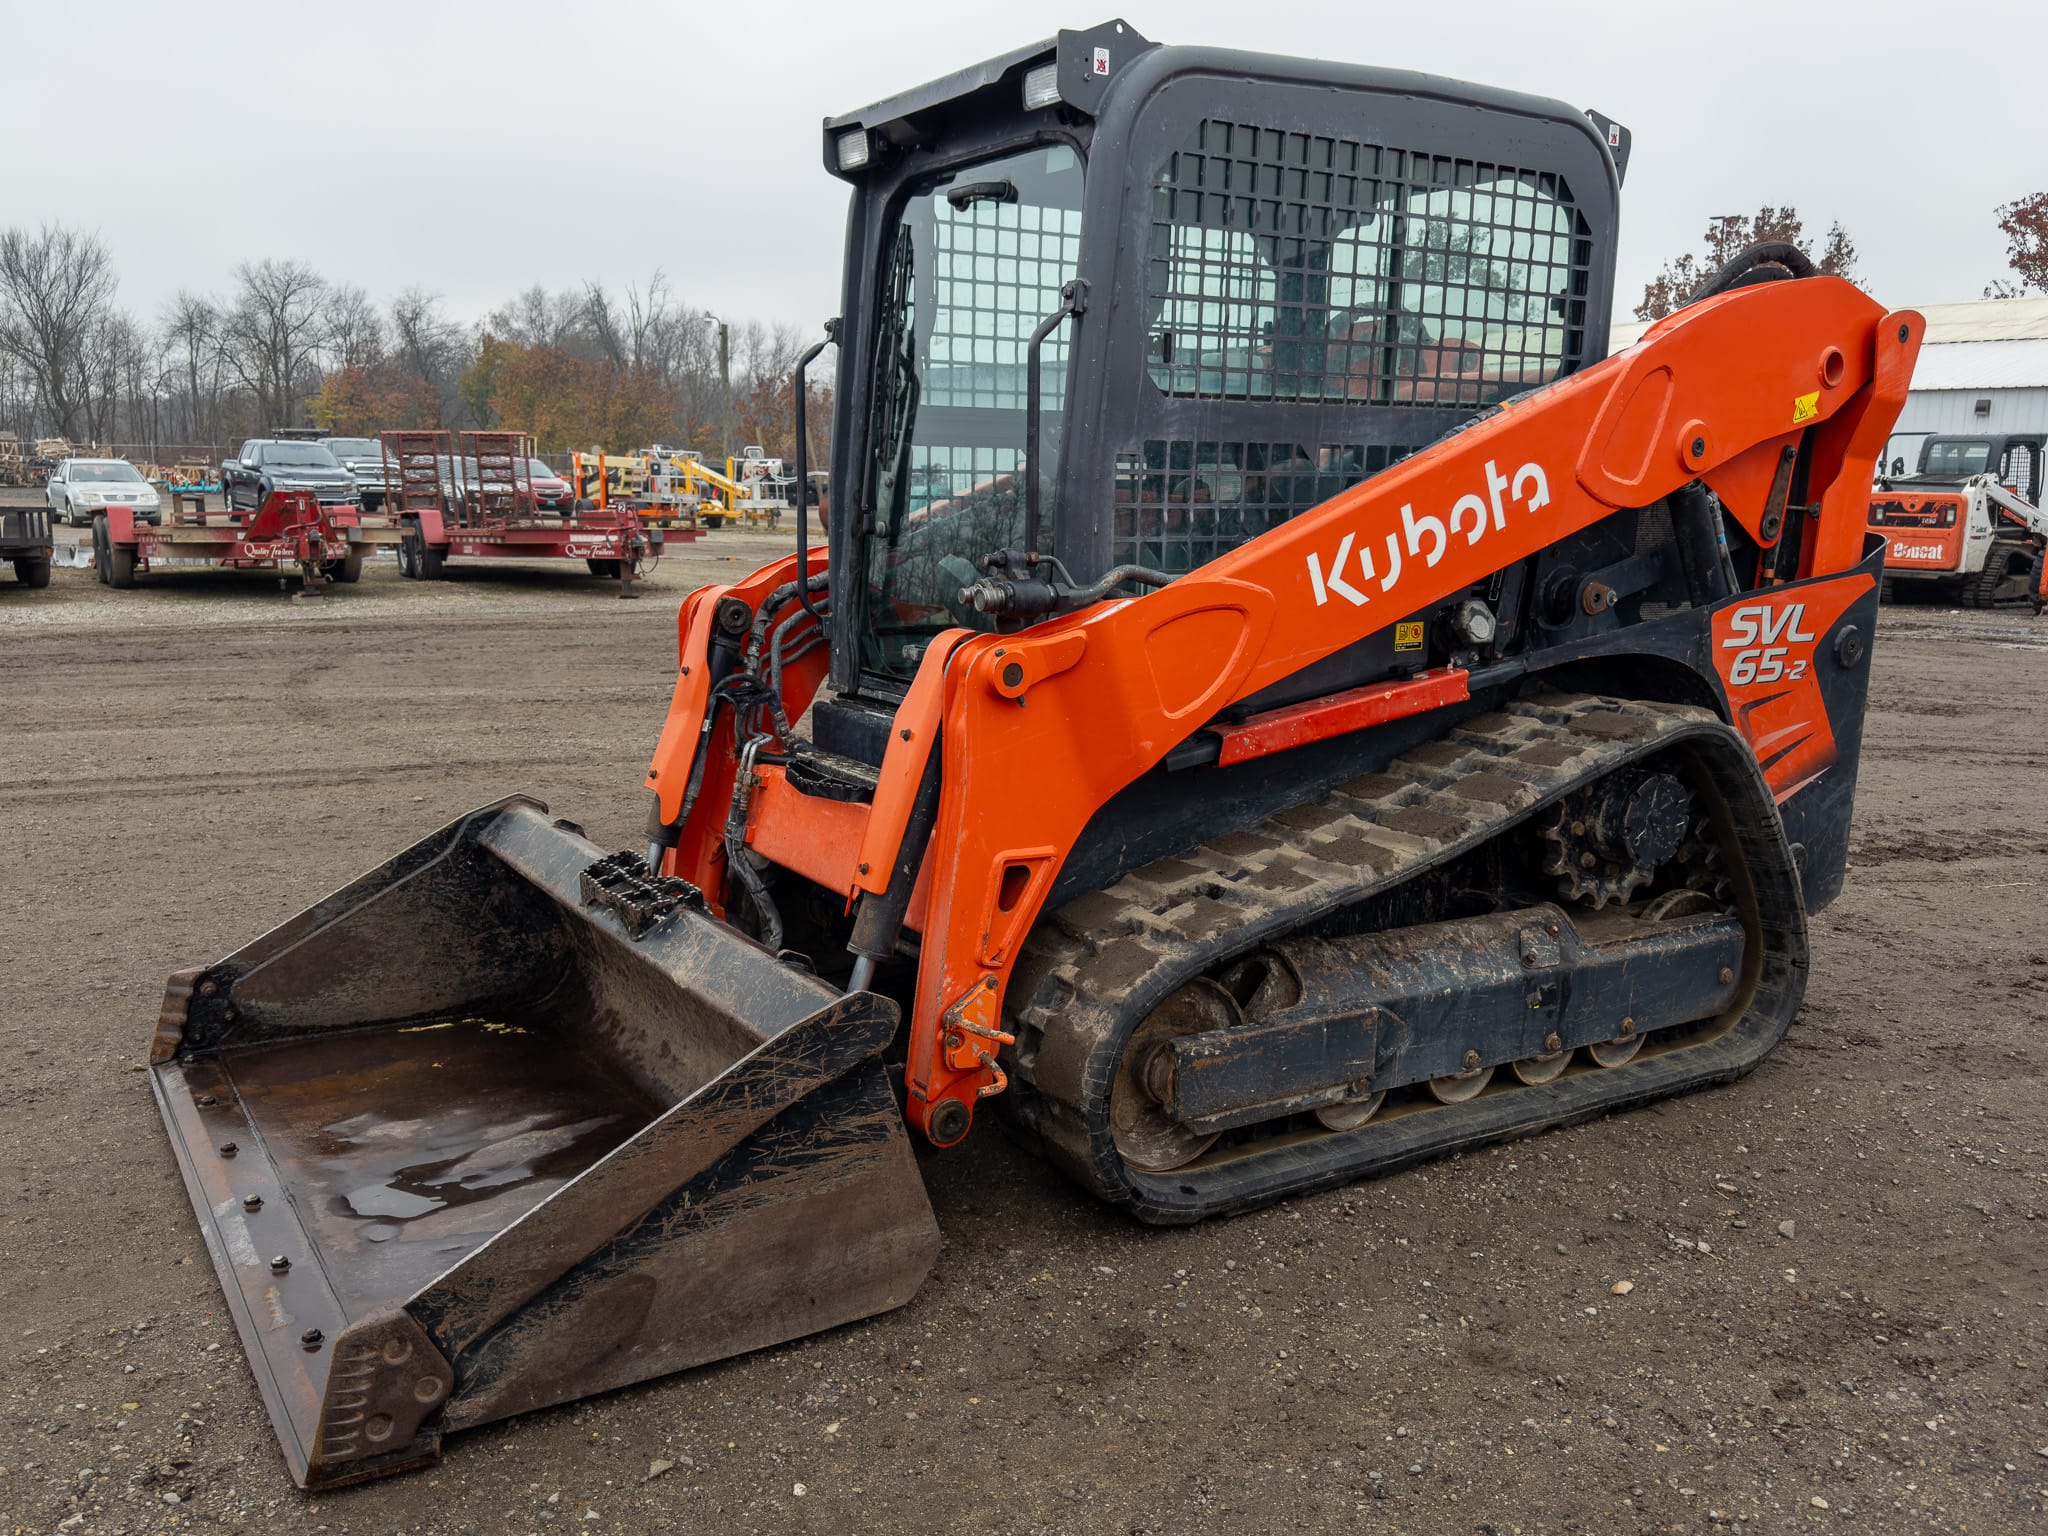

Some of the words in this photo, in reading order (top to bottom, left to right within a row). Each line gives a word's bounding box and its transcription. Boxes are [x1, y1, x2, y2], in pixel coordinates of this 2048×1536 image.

[618, 504, 626, 512] 2
[1306, 459, 1551, 607] Kubota
[244, 543, 270, 557] Quality
[565, 544, 592, 557] Quality
[591, 545, 615, 558] Trailers
[1893, 543, 1943, 560] Bobcat
[1722, 604, 1815, 648] SVL
[1729, 647, 1807, 686] 65-2
